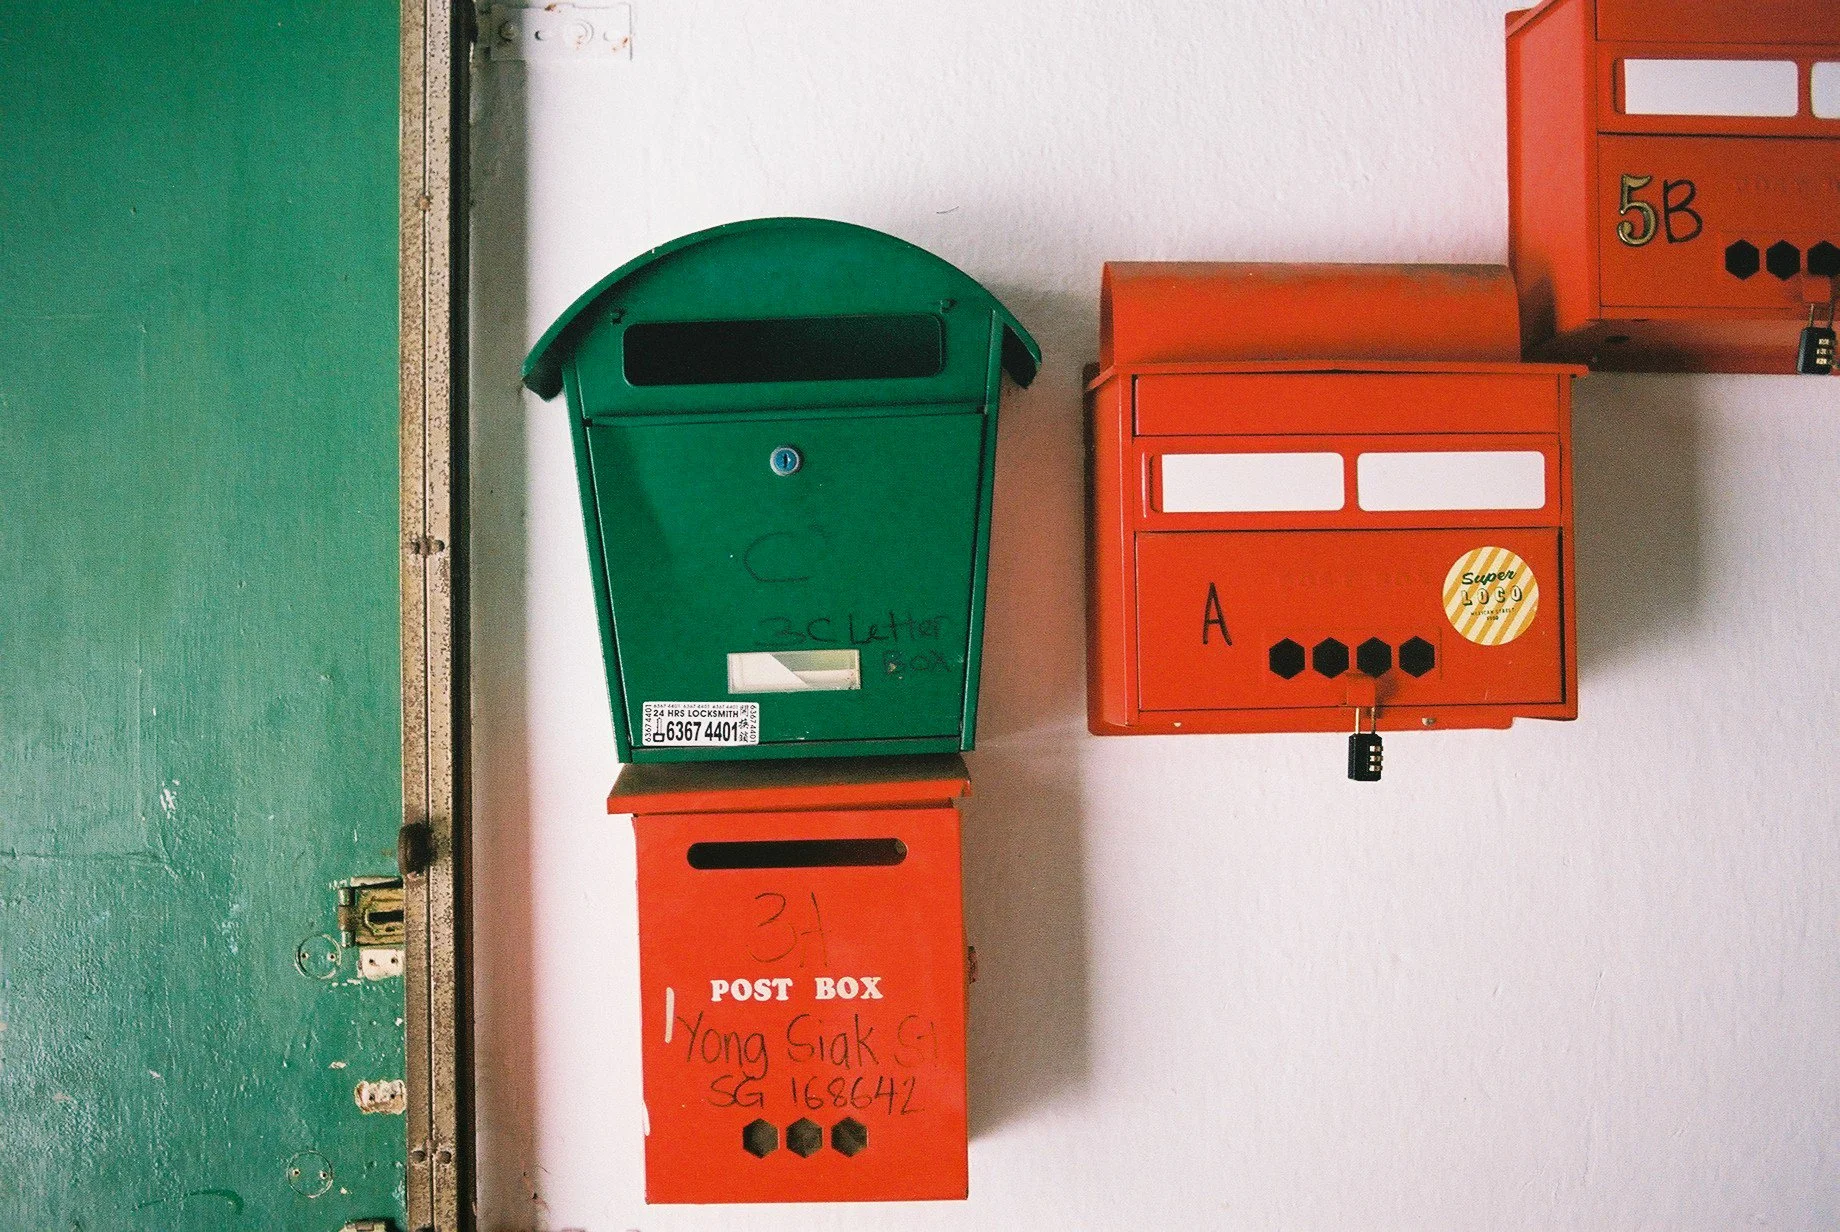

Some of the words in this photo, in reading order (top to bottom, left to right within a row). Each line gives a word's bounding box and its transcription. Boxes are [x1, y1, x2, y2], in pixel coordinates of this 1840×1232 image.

[1461, 570, 1517, 585] Super
[1461, 585, 1522, 606] LOCO
[1202, 582, 1233, 646] A
[653, 709, 664, 717] 24
[668, 709, 685, 718] HRS
[688, 709, 739, 718] LOCKSMITH
[666, 721, 702, 741] 6367
[704, 721, 738, 742] 4401
[710, 979, 794, 1002] POST
[815, 976, 884, 1000] BOX
[676, 1012, 769, 1080] Yong
[787, 1013, 880, 1068] Siak
[709, 1075, 766, 1109] SG
[786, 1075, 924, 1116] 168642
